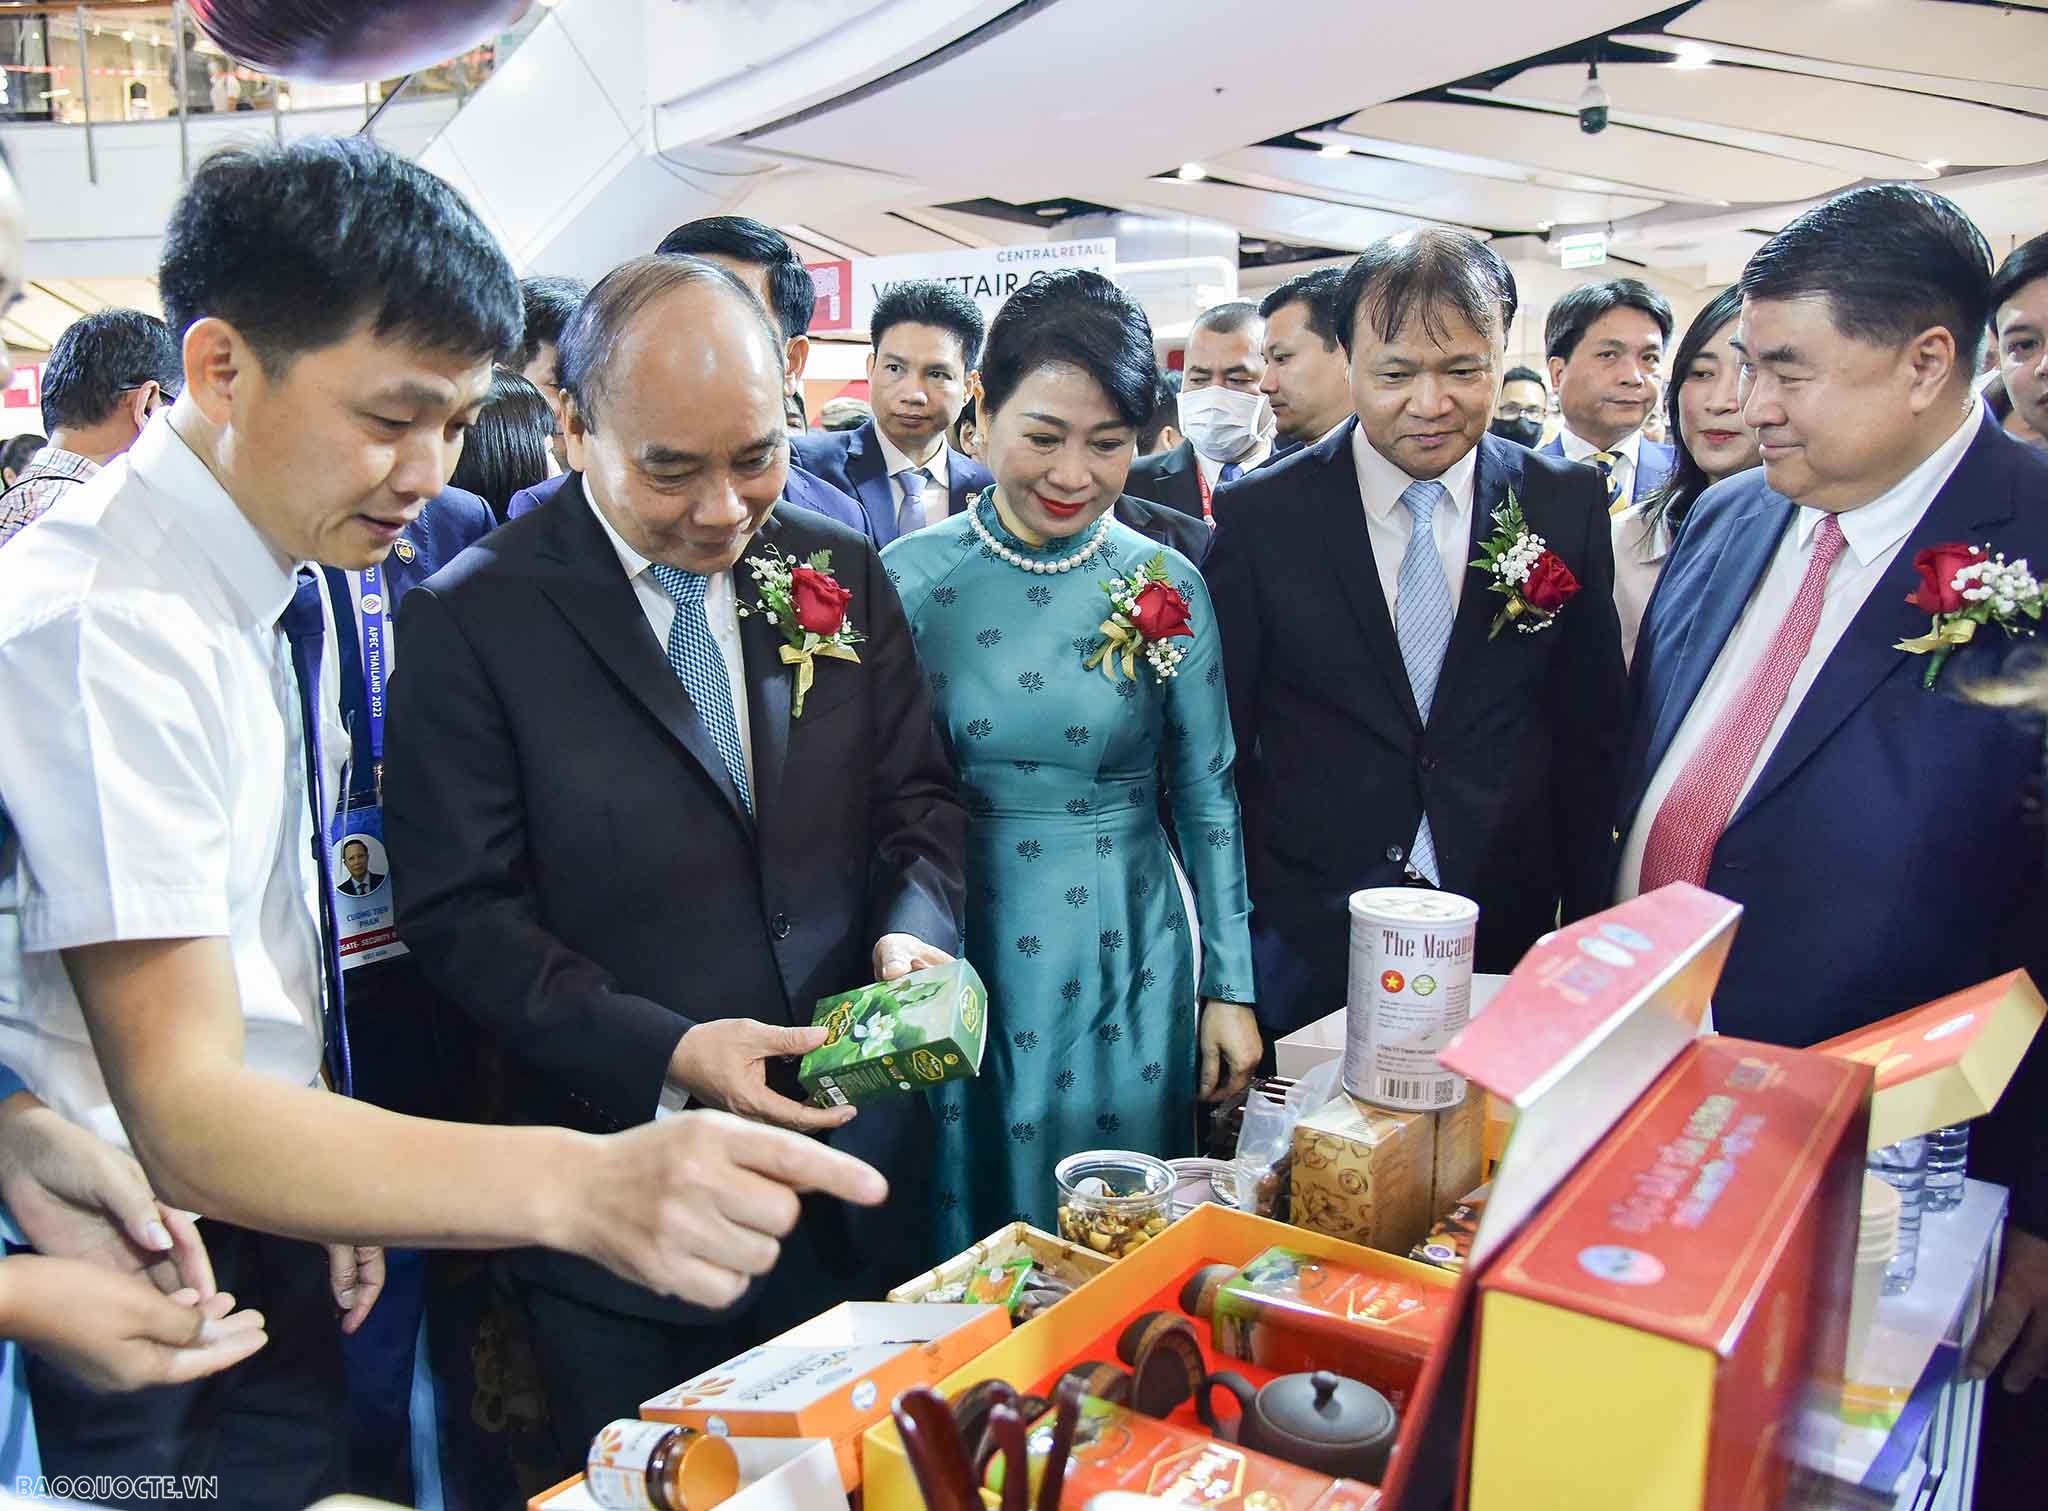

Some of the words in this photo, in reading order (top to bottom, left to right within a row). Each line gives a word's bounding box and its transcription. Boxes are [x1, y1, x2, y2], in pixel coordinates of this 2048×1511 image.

[368, 626, 379, 648] APEC
[369, 650, 382, 693] THAILAND
[371, 695, 383, 718] 2022
[1383, 930, 1415, 957] The
